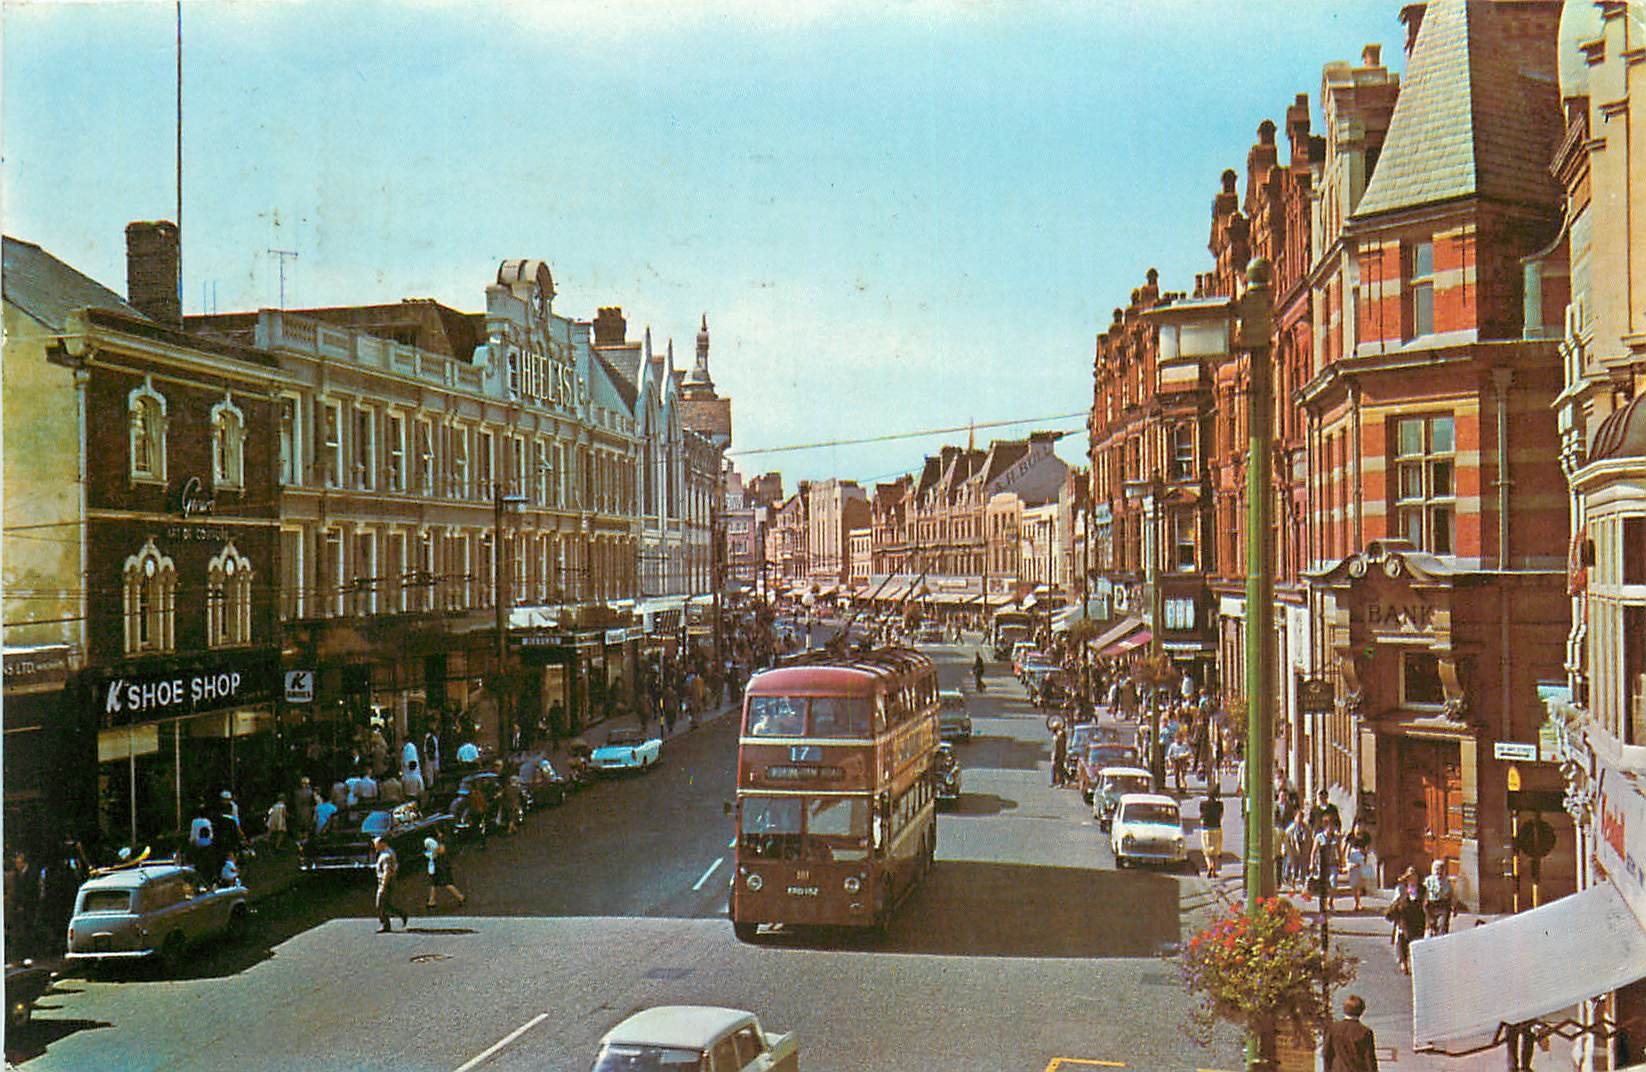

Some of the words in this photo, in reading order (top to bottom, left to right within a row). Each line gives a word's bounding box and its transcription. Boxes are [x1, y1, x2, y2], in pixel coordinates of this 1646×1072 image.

[1368, 604, 1434, 625] BANK
[291, 672, 306, 690] K
[106, 679, 124, 714] K
[127, 680, 184, 711] SHOE
[191, 672, 241, 702] SHOP
[791, 746, 810, 762] 17
